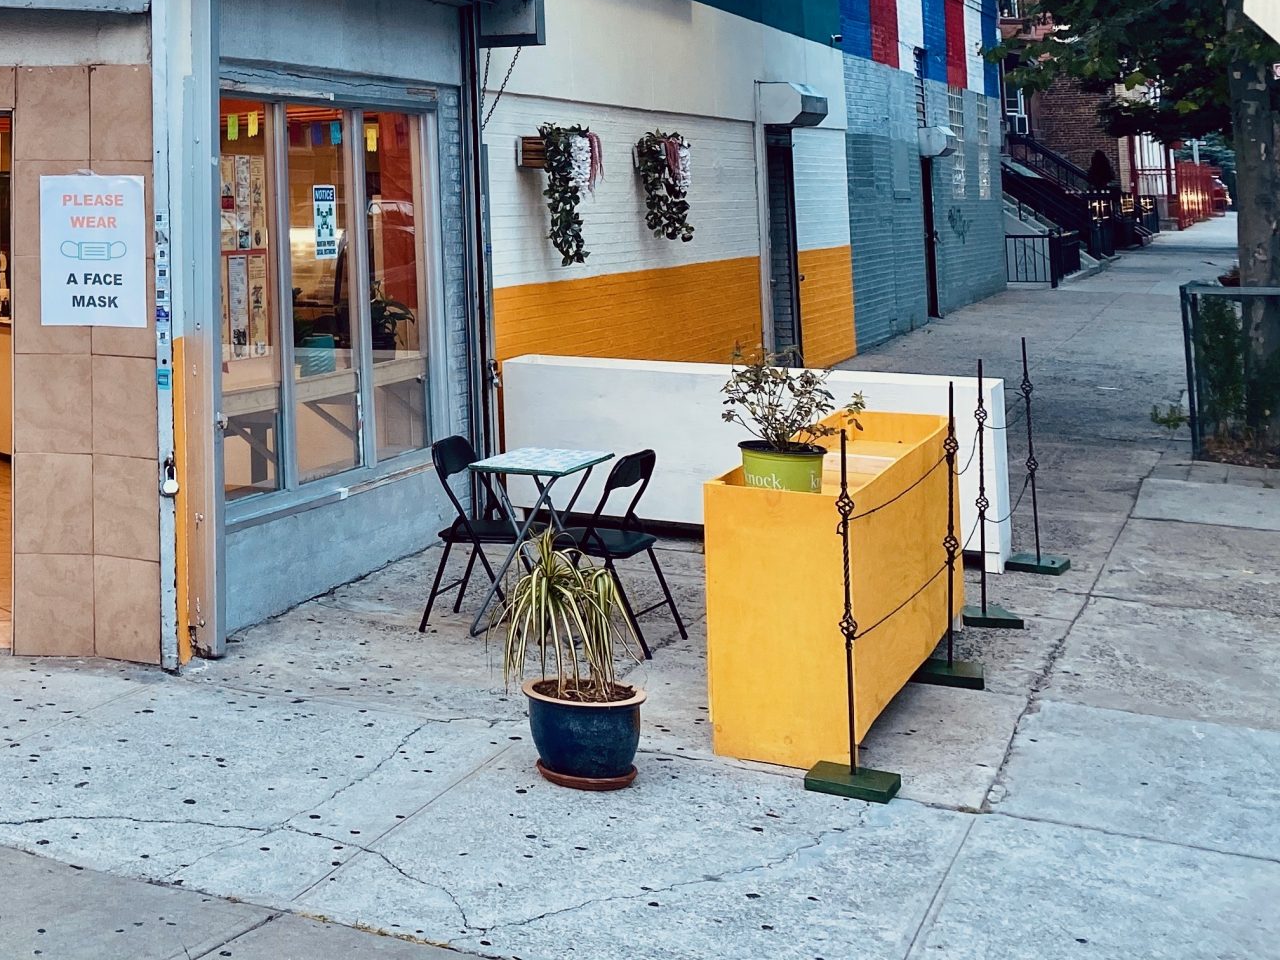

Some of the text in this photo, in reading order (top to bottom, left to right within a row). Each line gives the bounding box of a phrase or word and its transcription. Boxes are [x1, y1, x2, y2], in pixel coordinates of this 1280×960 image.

[62, 194, 124, 206] PLEASE
[315, 189, 334, 200] NOTICE
[70, 216, 117, 228] WEAR
[66, 273, 123, 286] A FACE
[72, 295, 119, 308] MASK
